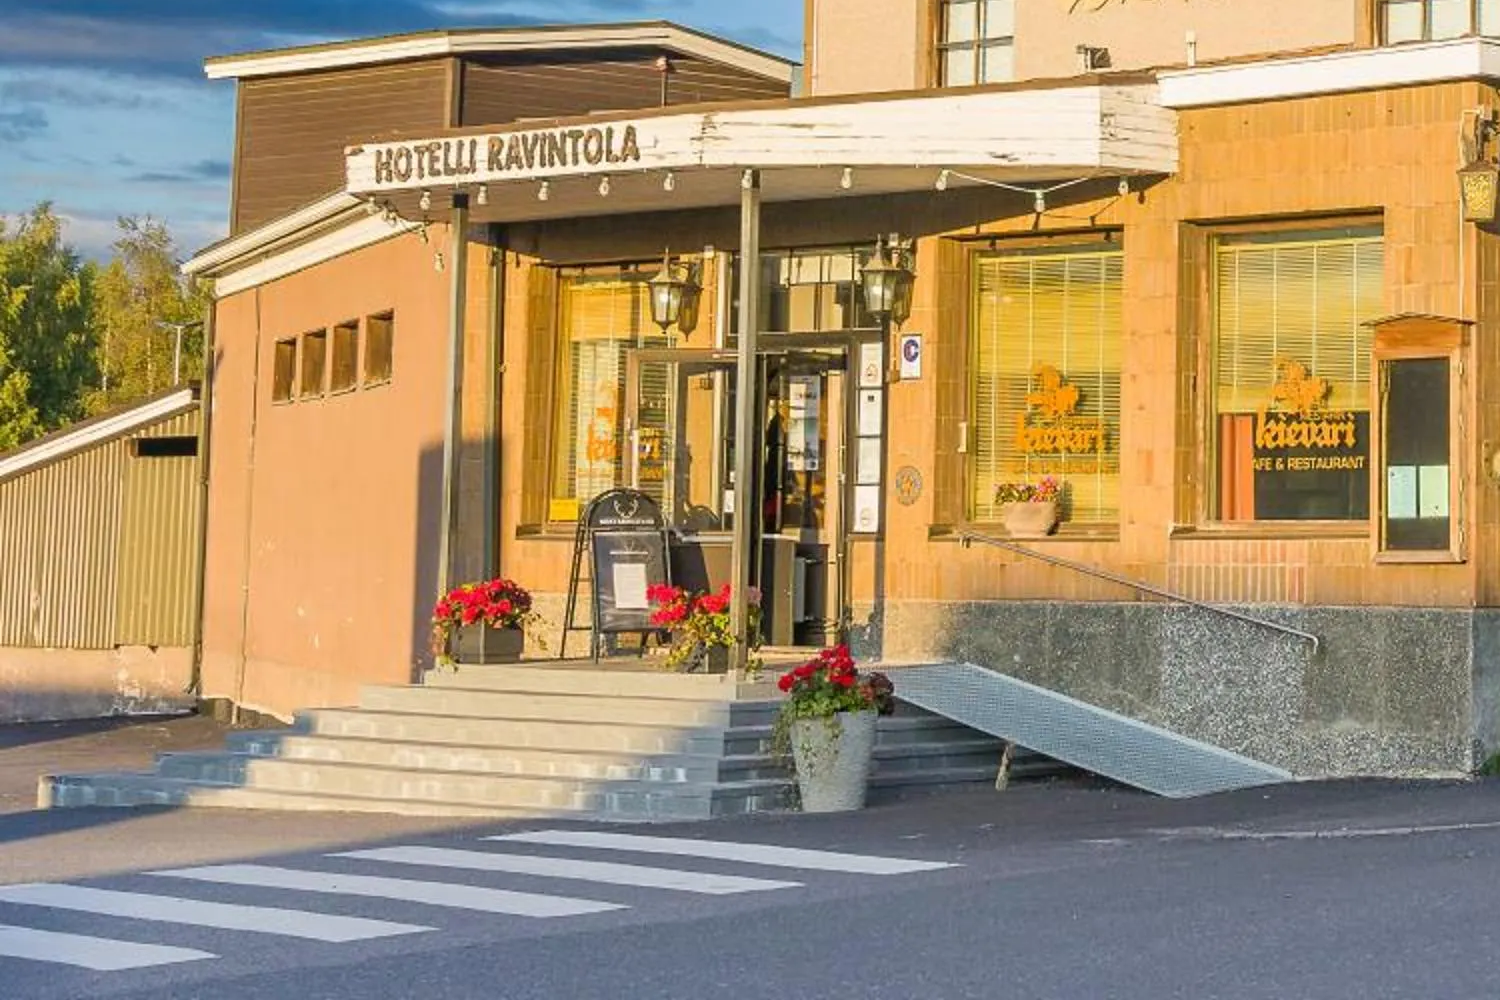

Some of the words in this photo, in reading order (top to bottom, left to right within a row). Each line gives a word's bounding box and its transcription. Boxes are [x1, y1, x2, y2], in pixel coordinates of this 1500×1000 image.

[375, 138, 477, 184] HOTELLI
[486, 124, 641, 172] RAVINTOLA
[1275, 457, 1285, 471] &
[1287, 455, 1365, 470] RESTAURANT
